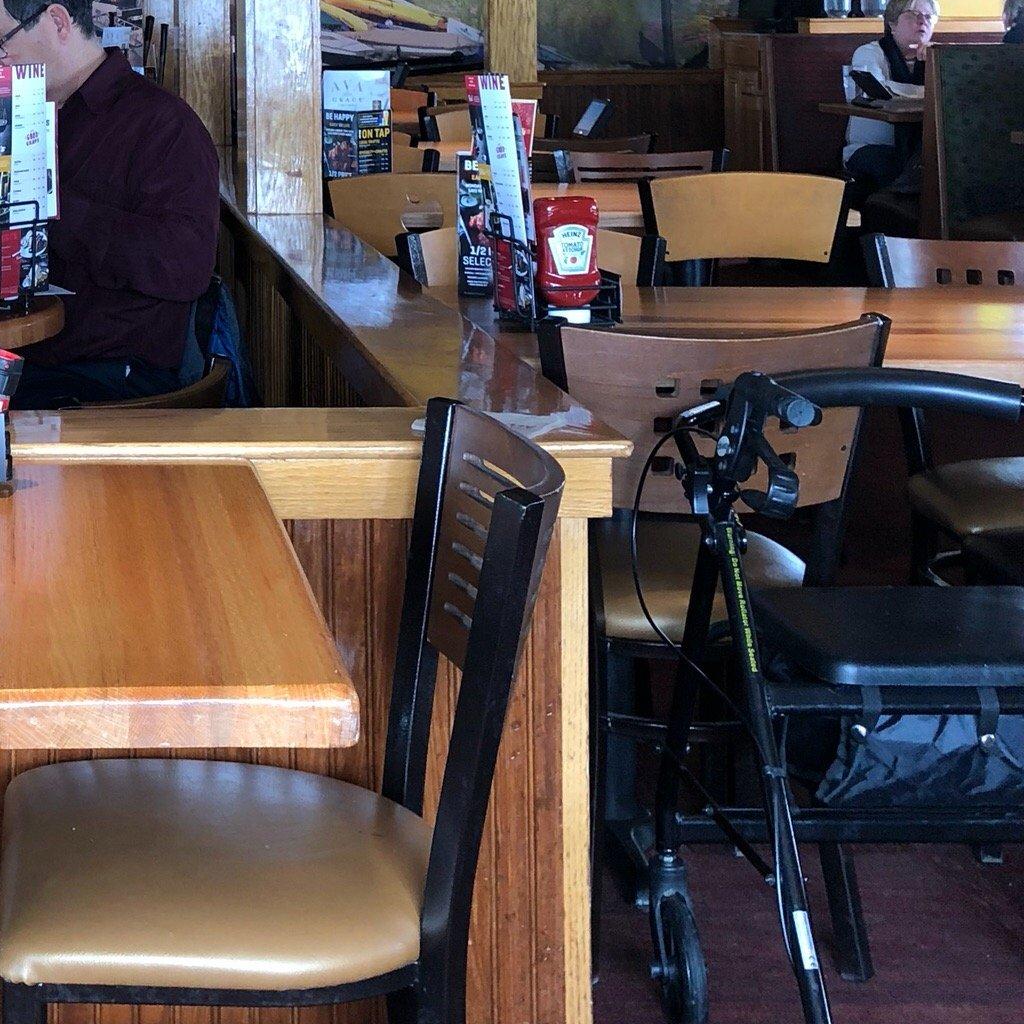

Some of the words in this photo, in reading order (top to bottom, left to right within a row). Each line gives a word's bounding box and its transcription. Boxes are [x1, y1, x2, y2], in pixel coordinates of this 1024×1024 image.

[15, 63, 45, 80] WINE
[480, 73, 506, 90] WINE
[325, 112, 333, 120] BE
[334, 113, 354, 122] HAPPY
[362, 129, 373, 139] ON
[374, 128, 390, 138] TAP
[464, 160, 479, 171] BE
[470, 246, 487, 256] 1/2
[747, 648, 758, 673] Seated
